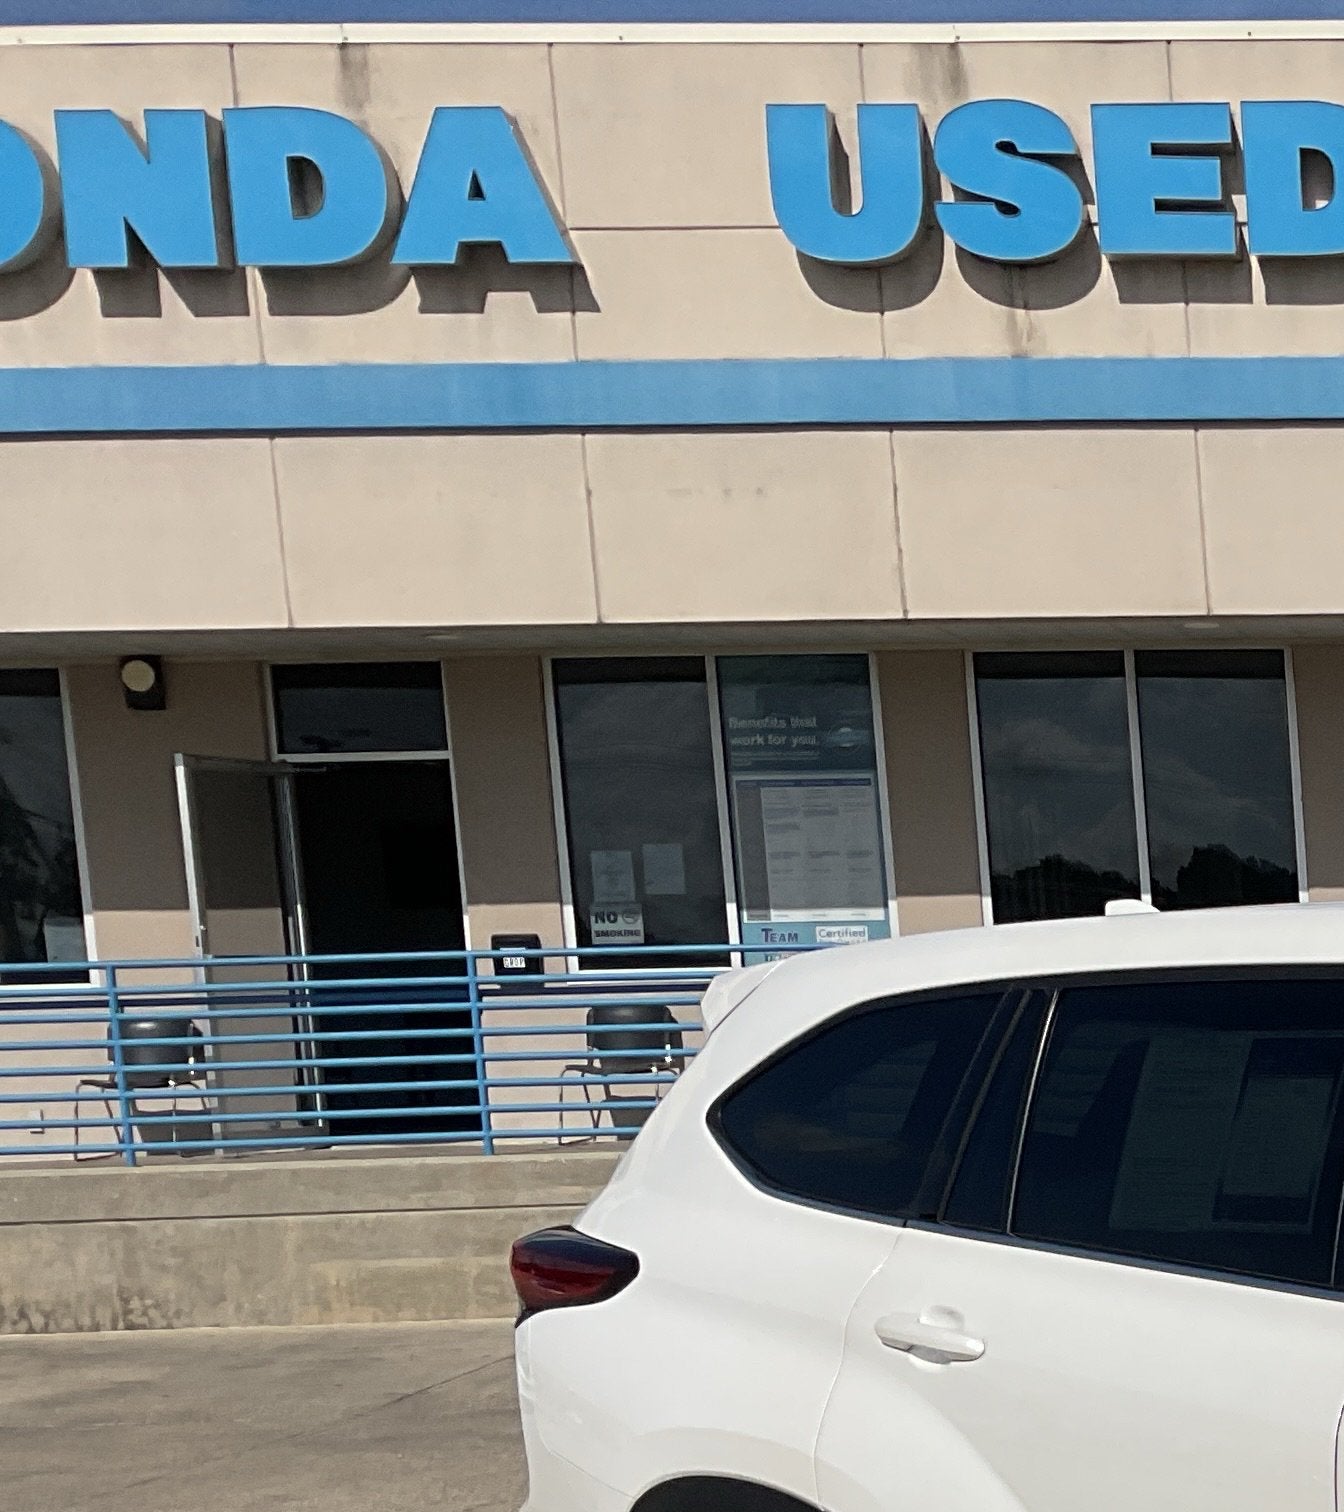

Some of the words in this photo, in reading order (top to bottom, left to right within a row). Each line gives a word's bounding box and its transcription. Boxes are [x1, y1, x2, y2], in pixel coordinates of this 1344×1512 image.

[594, 911, 618, 924] NO
[594, 929, 641, 938] SMOKING
[761, 927, 799, 943] TEAM
[818, 927, 866, 938] Certified
